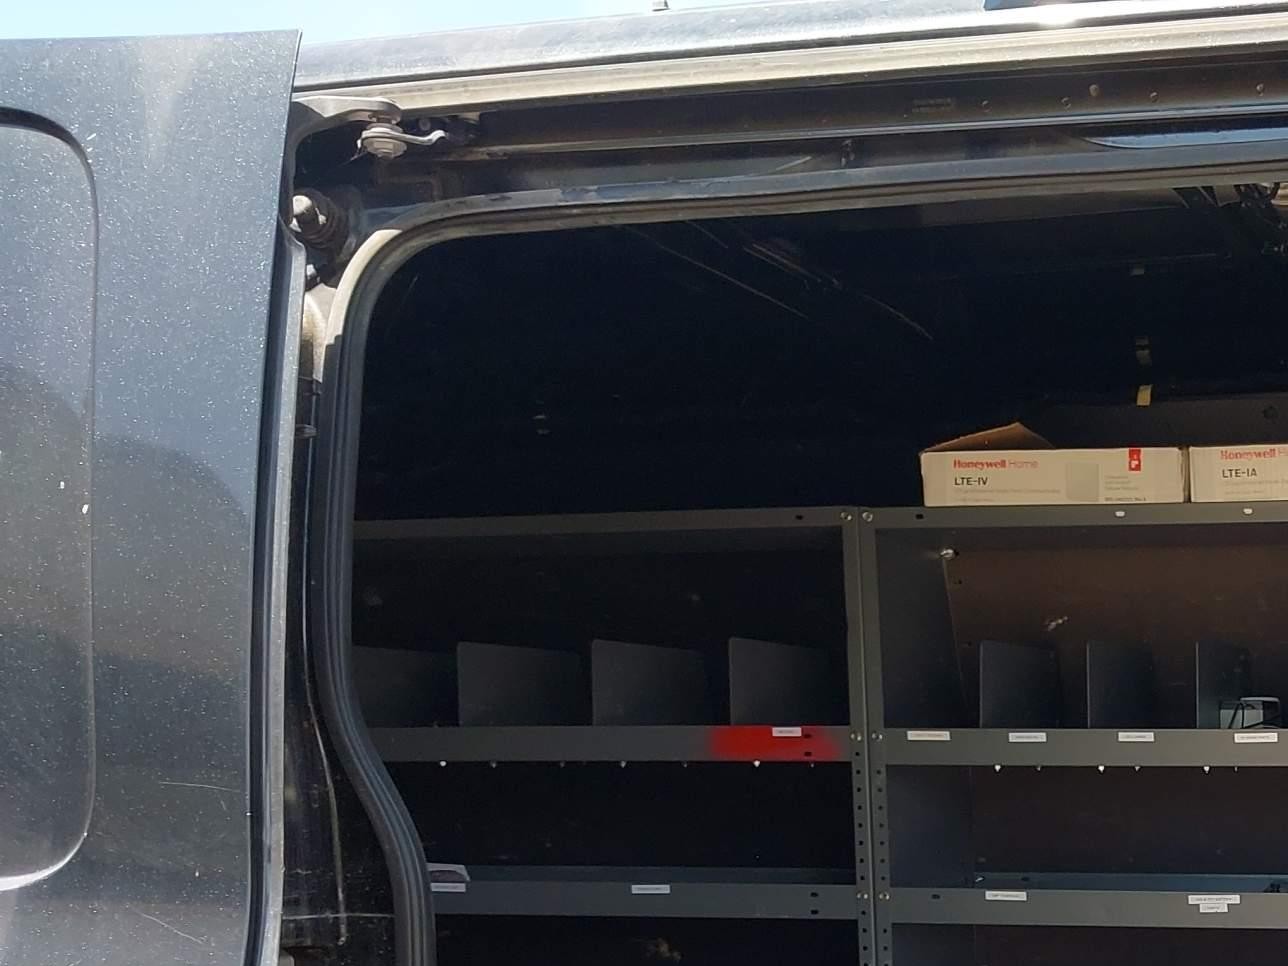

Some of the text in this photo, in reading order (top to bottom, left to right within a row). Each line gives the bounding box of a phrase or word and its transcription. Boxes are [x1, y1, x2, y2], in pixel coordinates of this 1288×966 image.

[1220, 447, 1276, 461] Honeywell
[953, 459, 1039, 471] Honeywell Home
[1221, 467, 1258, 479] LTE-IA
[954, 477, 988, 486] LTE-IV
